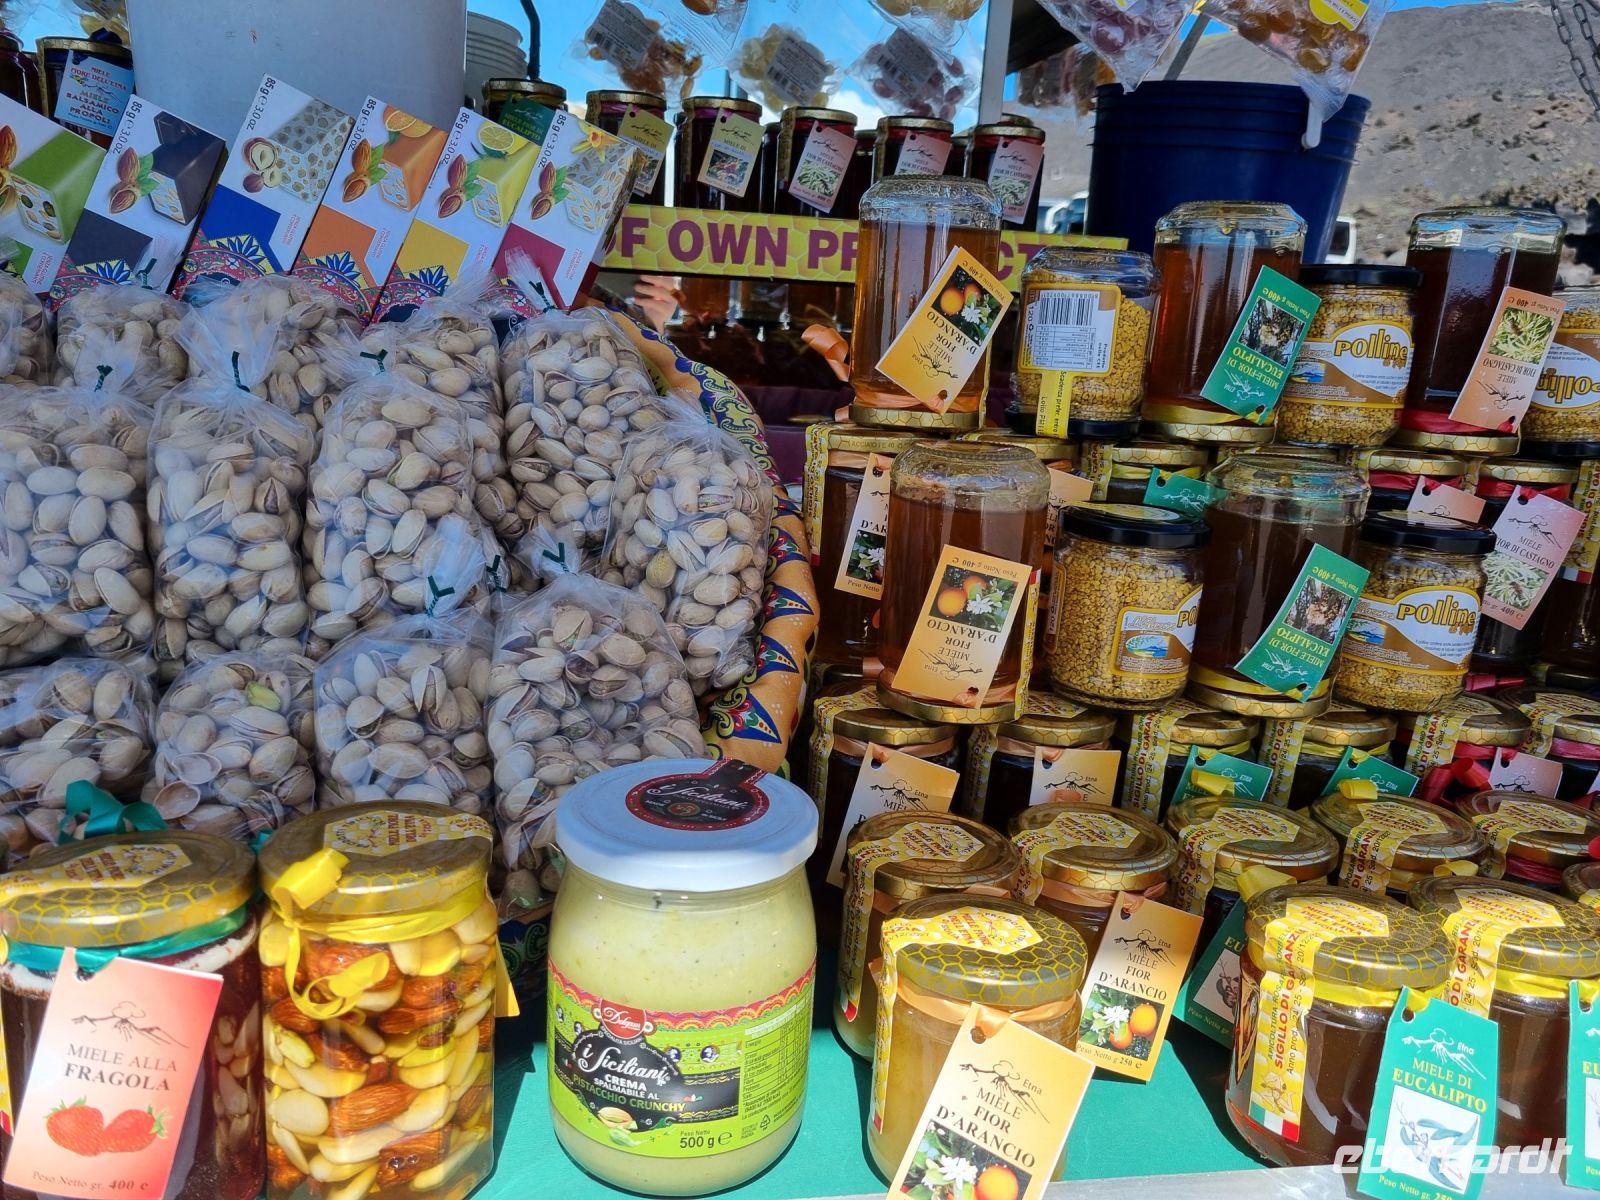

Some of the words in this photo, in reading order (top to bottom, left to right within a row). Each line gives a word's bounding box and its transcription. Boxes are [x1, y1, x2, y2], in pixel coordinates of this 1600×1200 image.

[264, 77, 276, 90] 85
[66, 92, 119, 113] BALSAMICO
[80, 105, 103, 115] ALLA
[131, 101, 142, 113] 85
[367, 99, 377, 110] 85
[70, 107, 112, 124] PROPOLI
[461, 112, 470, 124] 85
[557, 114, 566, 126] 85
[606, 217, 649, 258] F
[668, 220, 787, 267] OWN
[926, 311, 977, 355] D'ARANCIO
[935, 333, 957, 353] FIOR
[927, 341, 953, 363] MIELE
[1232, 347, 1284, 379] EUCALIPTO
[1483, 358, 1515, 373] CASTAGNO
[1515, 364, 1523, 374] DI
[1523, 365, 1537, 377] FIOR
[1057, 371, 1067, 397] Scadenza
[1497, 373, 1517, 385] MIELE
[1520, 536, 1542, 551] MIELE
[962, 559, 976, 568] 400
[1512, 545, 1520, 554] DI
[1520, 548, 1555, 569] CASTAGNO
[984, 564, 1000, 574] Netto
[847, 579, 862, 589] Peso
[863, 583, 880, 593] Netto
[1500, 606, 1515, 616] 400
[927, 619, 997, 644] D'ARANCIO
[945, 636, 971, 650] FIOR
[1268, 638, 1279, 647] DI
[1276, 627, 1329, 657] EUCALIPTO
[1280, 642, 1299, 656] FIOR
[937, 647, 970, 661] MIELE
[1301, 652, 1324, 667] MIELE
[1273, 739, 1281, 751] DI
[1421, 750, 1430, 766] DI
[1432, 750, 1440, 761] 25
[1133, 767, 1145, 808] SIGILLO
[1140, 752, 1147, 765] DI
[1193, 873, 1202, 884] 25
[1350, 874, 1363, 889] DI
[1364, 874, 1374, 885] 25
[1158, 939, 1171, 949] Etna
[1127, 952, 1158, 969] MIELE
[1126, 966, 1151, 981] FIOR
[1099, 971, 1167, 1001] D'ARANCIO
[1452, 977, 1463, 994] DI
[1468, 977, 1476, 989] 25
[1280, 993, 1290, 1010] DI
[1268, 1007, 1278, 1059] APICOLTURA
[1275, 1013, 1288, 1068] SIGILLO
[1287, 1053, 1296, 1074] Anno
[1294, 994, 1302, 1006] 25
[1077, 1044, 1093, 1055] Peso
[1095, 1049, 1112, 1061] Netto
[1119, 1057, 1132, 1067] 250
[1457, 1041, 1475, 1055] Etna
[68, 1044, 124, 1065] MIELE
[129, 1056, 177, 1072] ALLA
[578, 1047, 668, 1082] Siciliani
[64, 1063, 170, 1092] FRAGOLA
[1413, 1058, 1453, 1082] MIELE
[1458, 1074, 1472, 1089] DI
[594, 1077, 645, 1098] SPALMABILE
[649, 1092, 660, 1100] AL
[605, 1074, 647, 1091] CREMA
[1022, 1079, 1043, 1095] Etna
[1392, 1068, 1488, 1113] EUCALIPTO
[573, 1074, 626, 1105] PISTACCHIO
[630, 1100, 686, 1112] CRUNCHY
[977, 1087, 1023, 1120] MIELE
[974, 1106, 1011, 1134] FIOR
[679, 1136, 704, 1149] 500
[707, 1136, 715, 1148] g
[936, 1105, 1035, 1168] D'ARANCIO
[33, 1171, 55, 1184] Peso
[57, 1175, 87, 1188] Netto
[108, 1179, 134, 1191] 400
[1379, 1175, 1397, 1189] Peso
[1399, 1181, 1420, 1196] Netto
